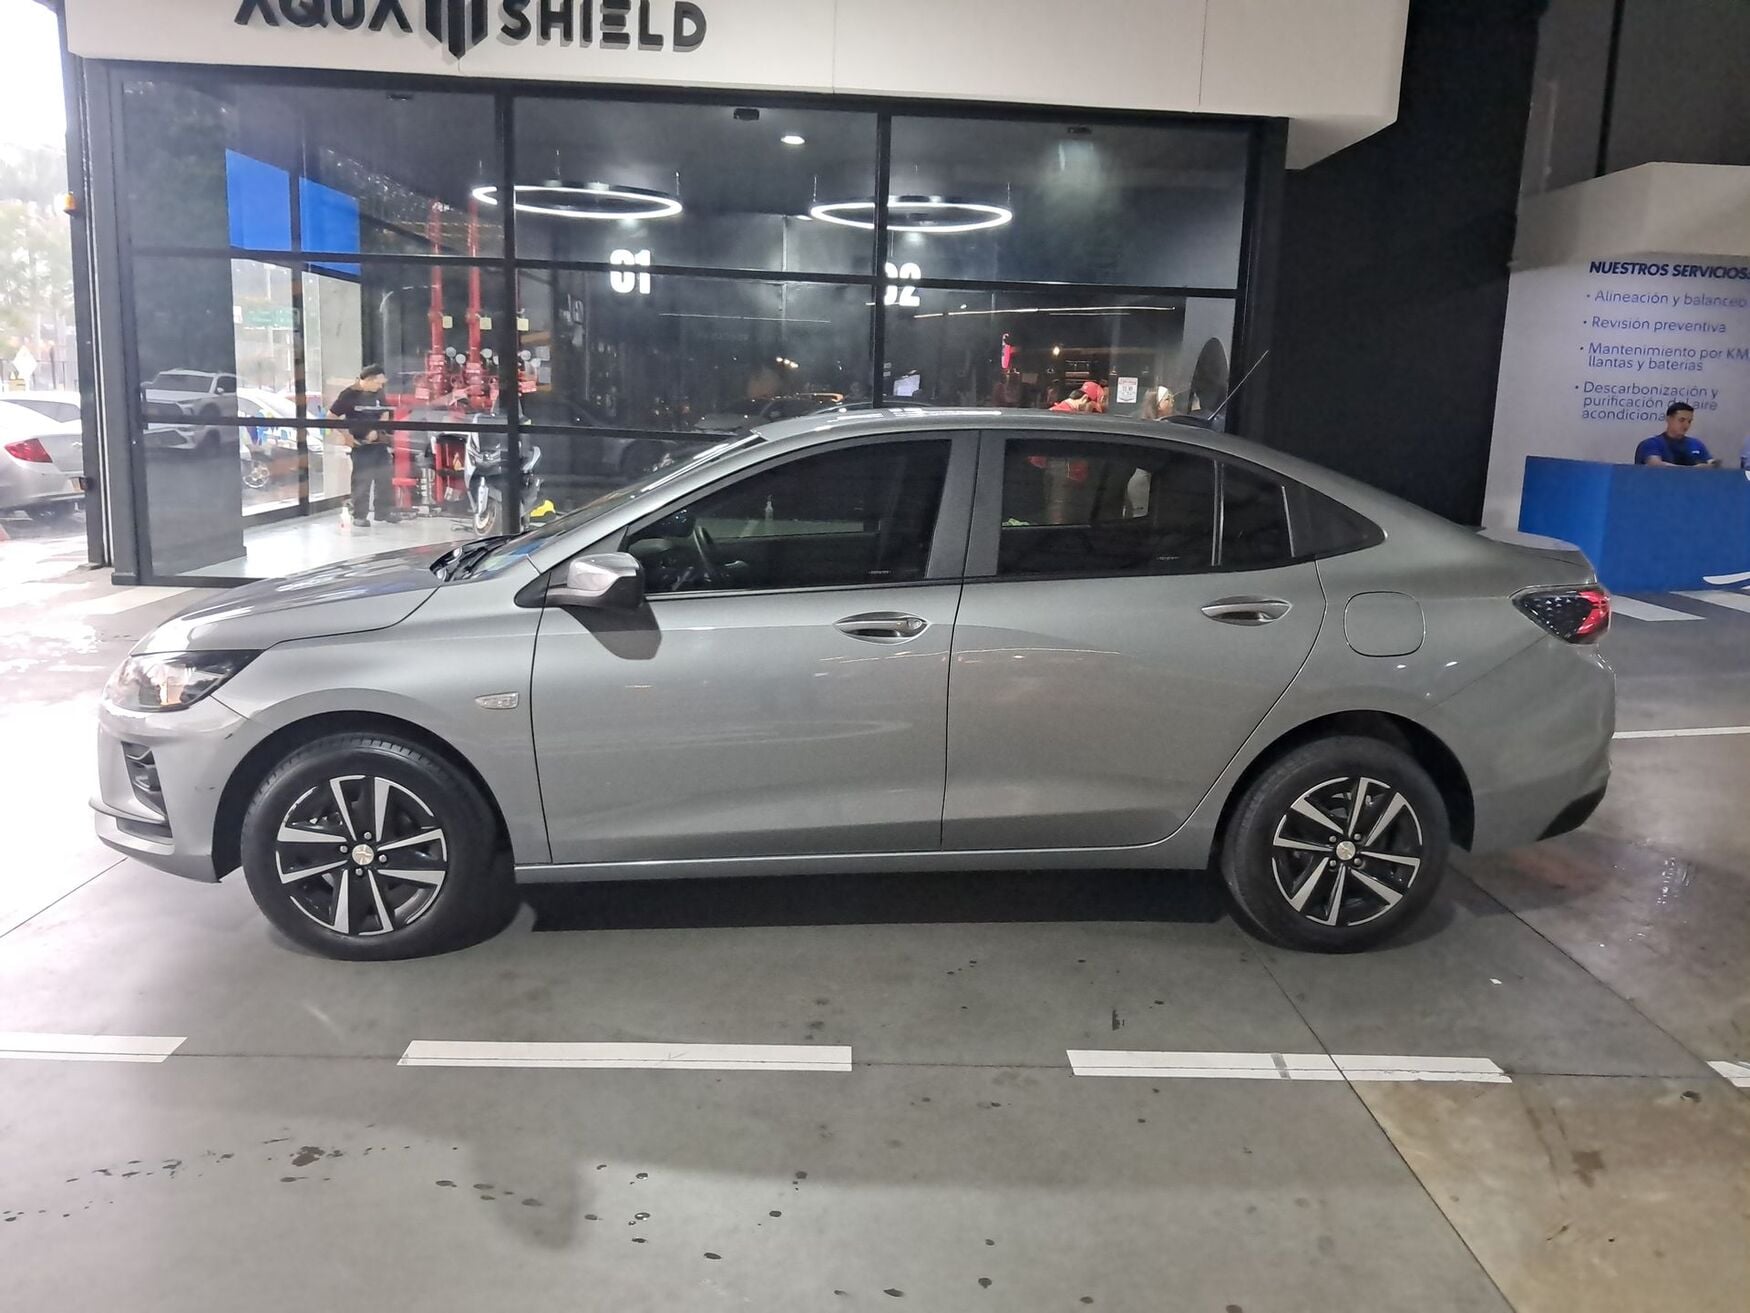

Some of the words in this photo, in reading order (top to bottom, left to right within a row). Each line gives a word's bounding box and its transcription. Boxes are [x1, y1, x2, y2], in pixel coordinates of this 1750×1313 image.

[499, 0, 708, 49] SHIELD
[609, 249, 651, 295] 01
[1589, 261, 1669, 277] NUESTROS
[1672, 295, 1682, 307] y
[1683, 292, 1748, 308] balanceo
[1653, 319, 1727, 334] preventiva
[1588, 342, 1697, 359] Mantenimiento
[1699, 348, 1723, 361] por
[1588, 356, 1633, 370] llantas
[1636, 359, 1645, 372] y
[1711, 387, 1720, 400] y
[1692, 400, 1718, 411] aire
